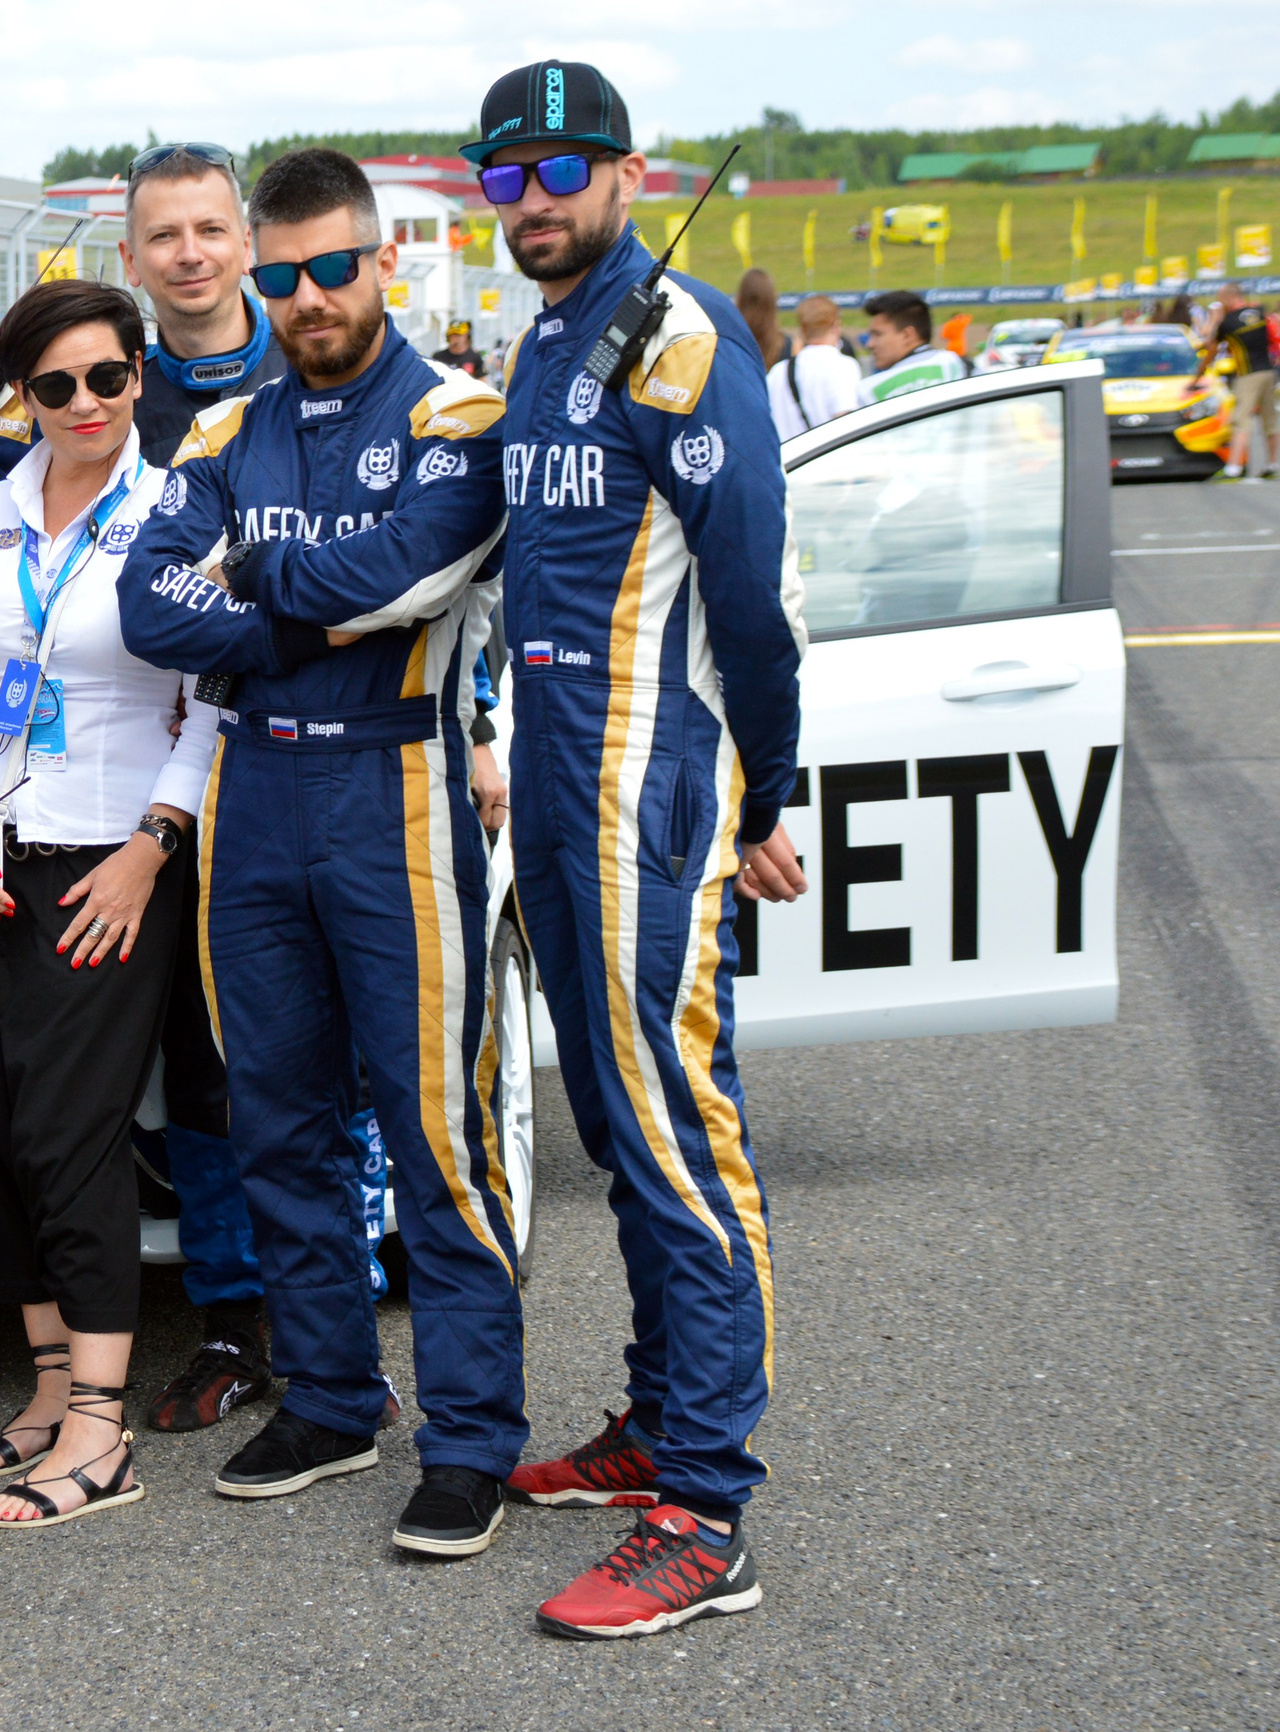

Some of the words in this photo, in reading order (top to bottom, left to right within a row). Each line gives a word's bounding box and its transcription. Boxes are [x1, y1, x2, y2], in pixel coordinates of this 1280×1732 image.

[545, 67, 564, 130] sparco
[300, 399, 343, 419] freem
[543, 444, 605, 507] CAR
[558, 648, 591, 665] Levin
[306, 722, 344, 737] Stepin
